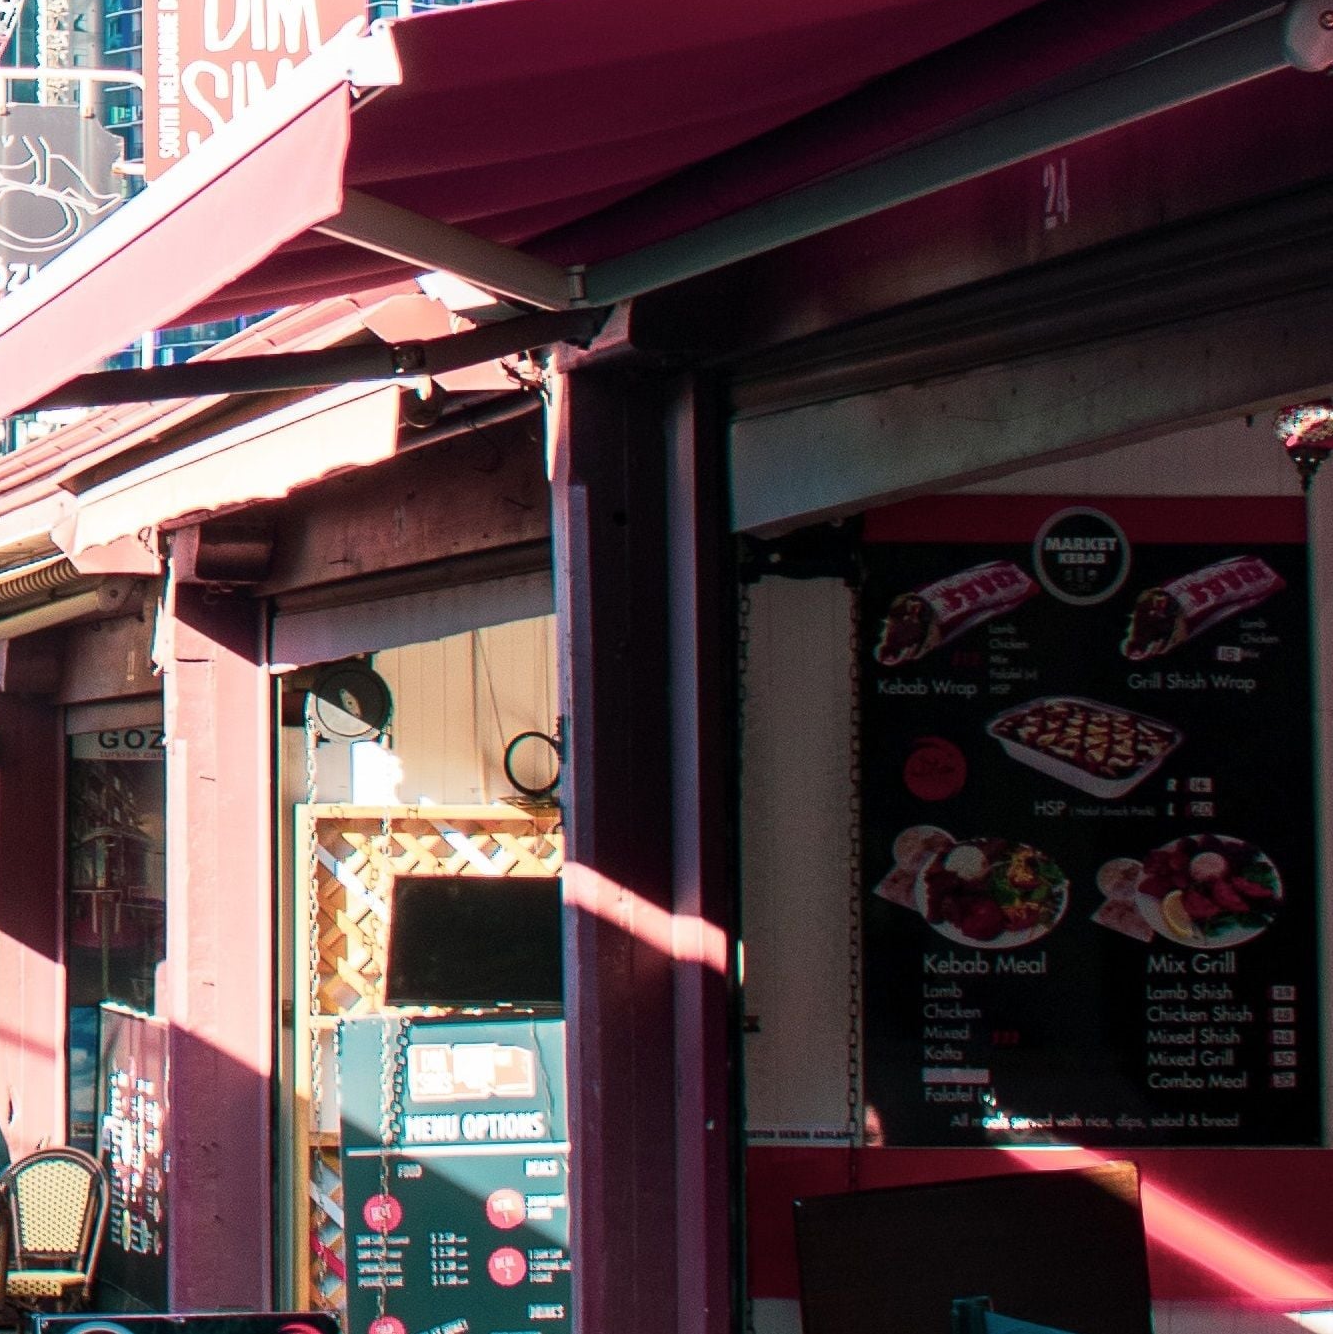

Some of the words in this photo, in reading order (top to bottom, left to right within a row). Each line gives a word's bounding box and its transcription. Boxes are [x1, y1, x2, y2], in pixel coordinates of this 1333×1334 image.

[1044, 537, 1118, 552] MARKET
[877, 677, 929, 696] Kebab
[932, 678, 978, 699] Wrap
[1127, 673, 1162, 690] Grill
[1166, 673, 1208, 690] Shish
[1211, 674, 1257, 693] Wrap
[923, 951, 990, 974] Kebab
[995, 951, 1048, 974] Meal
[1147, 953, 1187, 973] Mix
[1192, 951, 1236, 974] Grill
[923, 981, 963, 999] Lamb
[1146, 982, 1189, 1000] Lamb
[1191, 982, 1233, 1000] Shish
[923, 1003, 982, 1020] Chicken
[1146, 1004, 1209, 1022] Chicken
[1211, 1004, 1254, 1022] Shish
[1146, 1027, 1196, 1044] Mixed
[1199, 1027, 1241, 1044] Shish
[1147, 1049, 1196, 1066] Mixed
[1199, 1048, 1234, 1066] Grill
[1147, 1071, 1205, 1089] Combo
[1207, 1071, 1248, 1089] Meal
[403, 1114, 460, 1141] MENU
[461, 1111, 547, 1140] OPTIONS
[1201, 1113, 1240, 1128] bread
